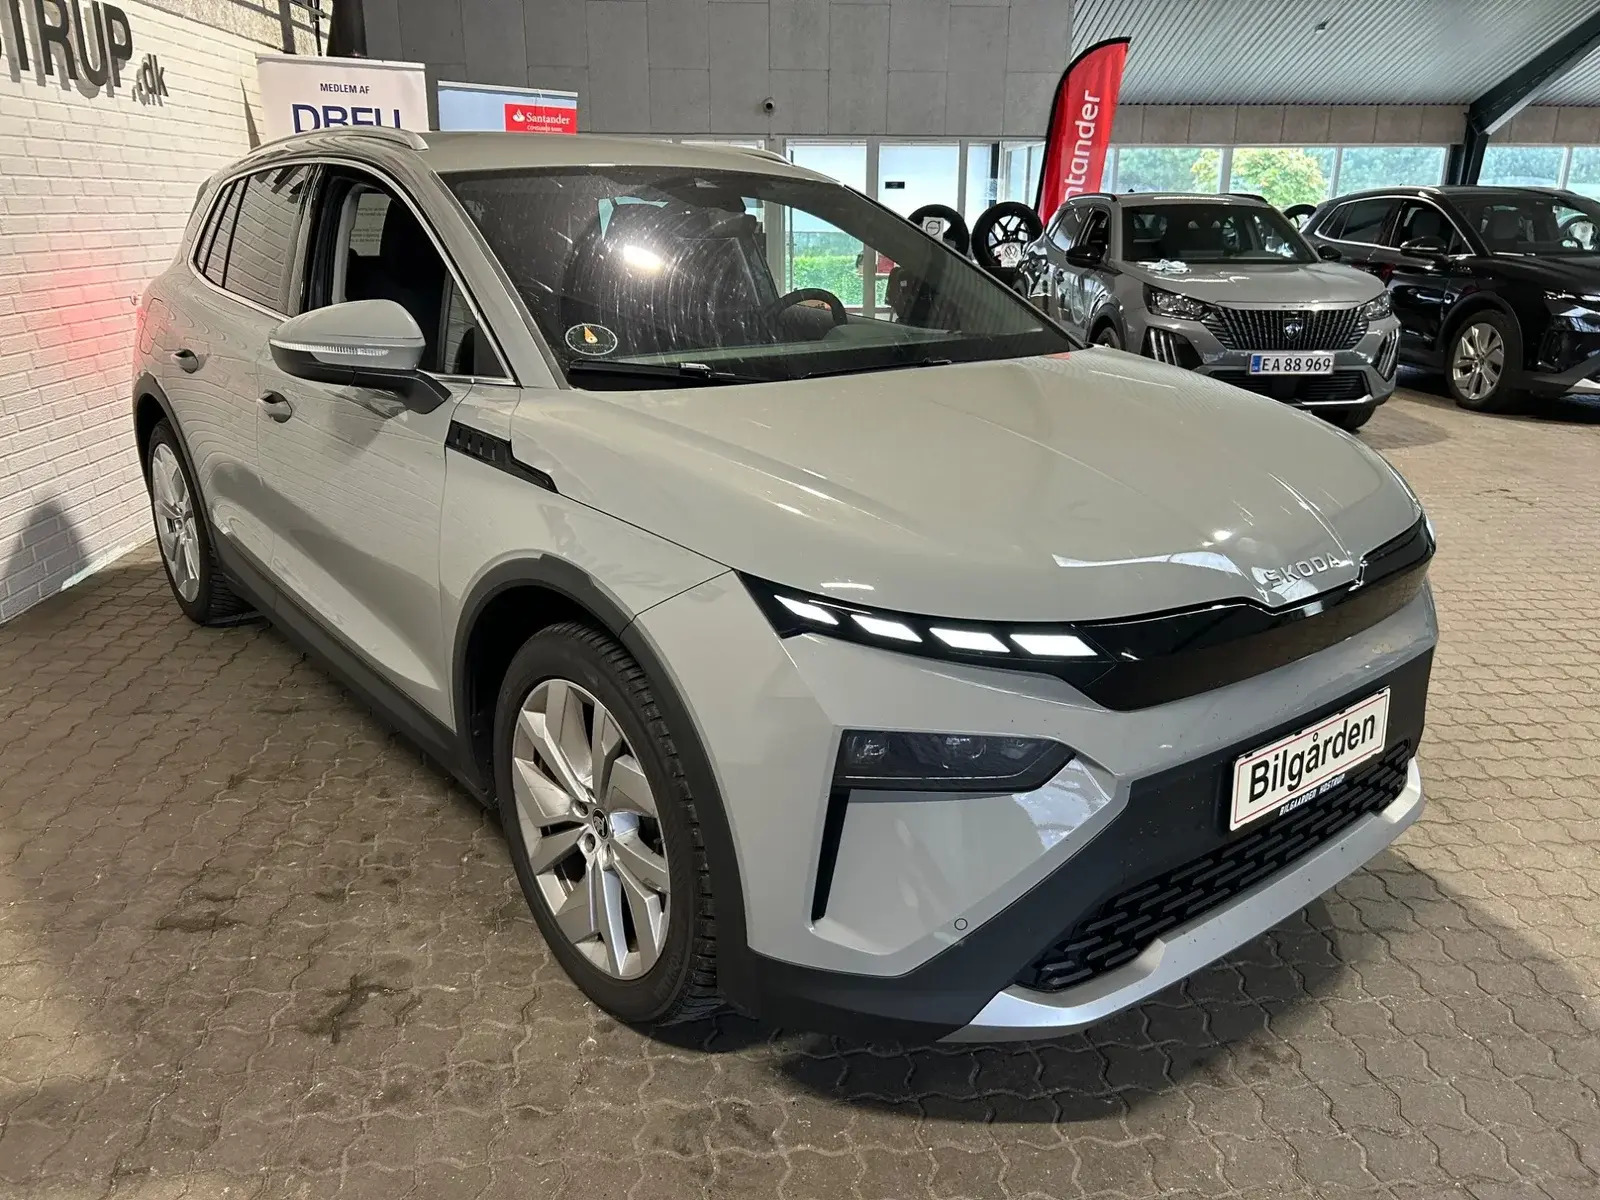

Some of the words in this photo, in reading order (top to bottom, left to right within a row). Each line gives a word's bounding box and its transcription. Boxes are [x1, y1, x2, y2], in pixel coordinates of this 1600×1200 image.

[320, 83, 357, 93] MEDLEM
[360, 85, 370, 94] AF
[526, 112, 570, 124] Santander
[1262, 358, 1280, 371] EA
[1284, 358, 1301, 371] 88
[1305, 358, 1331, 371] 969
[1249, 714, 1375, 803] Bilgården
